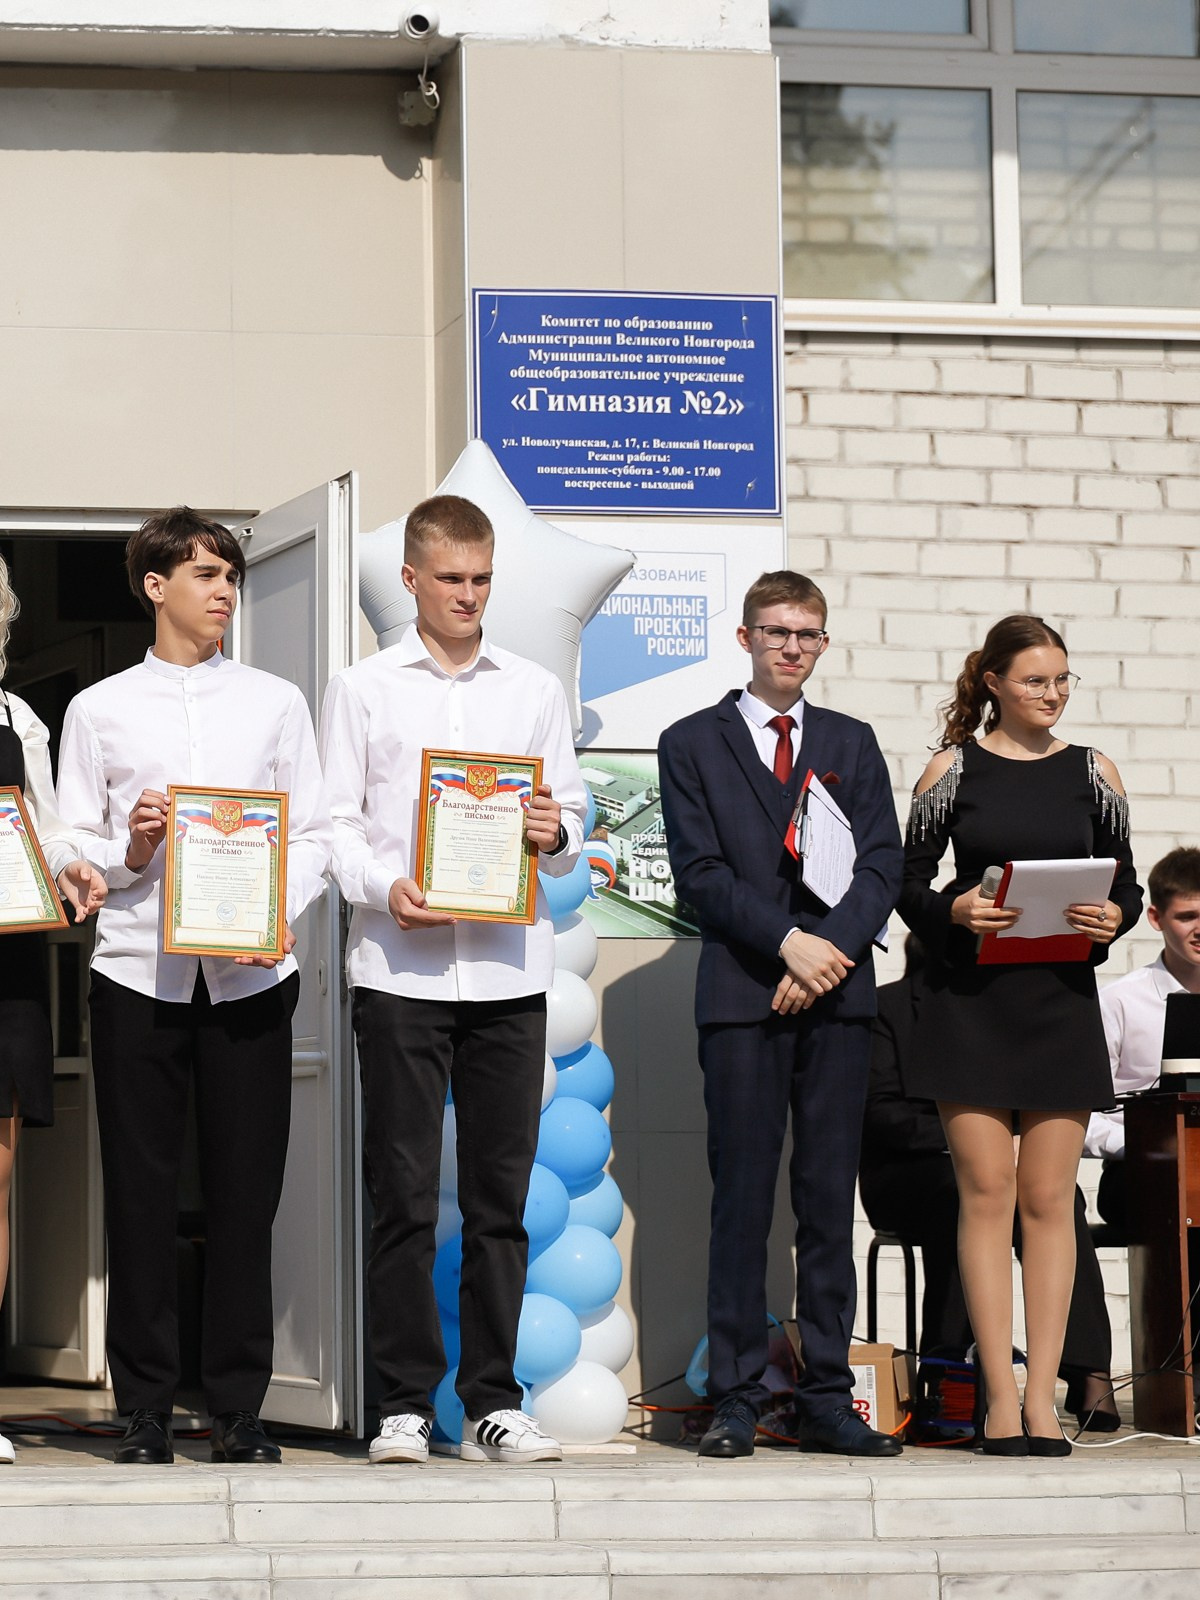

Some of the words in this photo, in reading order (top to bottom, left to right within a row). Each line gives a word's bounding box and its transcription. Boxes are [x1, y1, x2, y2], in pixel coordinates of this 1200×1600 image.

[541, 315, 599, 328] Комитет
[604, 318, 620, 328] по
[624, 316, 713, 332] образованию
[498, 332, 611, 346] Администрации
[616, 333, 679, 347] Великого
[684, 335, 754, 350] Новгорода
[529, 350, 642, 364] Муниципальное
[647, 353, 725, 365] автономное
[510, 367, 660, 381] общеобразовательное
[664, 372, 744, 384] учреждение
[511, 387, 671, 414] «Гимназия
[680, 390, 744, 415] №2»
[502, 438, 518, 448] ул.
[521, 437, 609, 449] Новолучанская,
[612, 439, 621, 449] д.
[625, 439, 639, 449] 17,
[643, 441, 649, 449] г.
[653, 439, 699, 450] Великий
[704, 441, 754, 452] Новгород
[588, 452, 624, 463] Режим
[627, 453, 670, 464] работы:
[537, 466, 653, 477] понедельник-суббота
[662, 467, 684, 476] 9.00
[694, 467, 721, 477] 17.00
[564, 480, 631, 490] воскресенье
[641, 480, 694, 490] выходной
[629, 569, 706, 582] АЗОВАНИЕ
[598, 597, 704, 616] ЦИОНАЛЬНЫЕ
[634, 617, 704, 636] ПРОЕКТЫ
[648, 637, 705, 656] РОССИИ
[442, 800, 518, 814] Благодарственное
[464, 812, 495, 820] письмо
[189, 835, 265, 848] Благодарственное
